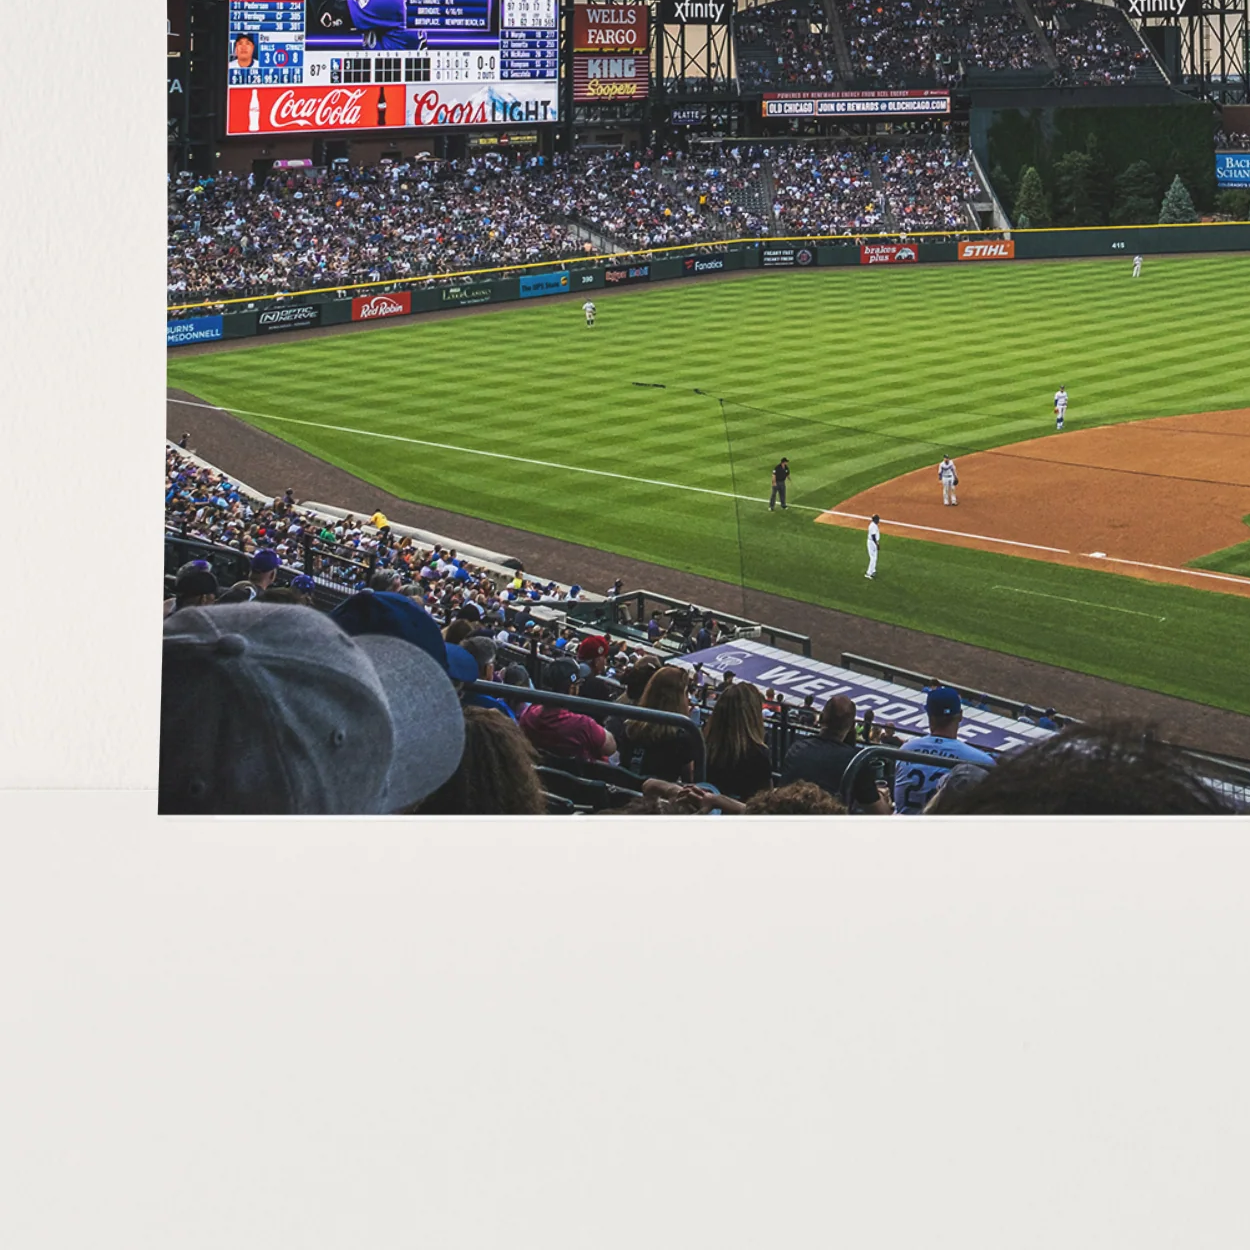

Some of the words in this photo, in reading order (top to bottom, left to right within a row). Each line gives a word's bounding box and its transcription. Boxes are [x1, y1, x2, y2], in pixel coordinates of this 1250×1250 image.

[586, 8, 637, 25] WELLS
[587, 29, 637, 45] FARGO
[477, 55, 495, 70] 0-0
[587, 58, 636, 79] KING
[586, 79, 638, 100] Soopers
[270, 88, 367, 128] Coca-Cola
[413, 90, 488, 126] Coors
[491, 100, 552, 122] LIGHT
[768, 102, 783, 114] OLD
[783, 102, 813, 114] CHICAGO
[818, 101, 835, 112] JOIN
[847, 100, 880, 112] REWARDS
[888, 99, 947, 111] OLDCHICAGO.COM
[673, 110, 699, 119] PLATTE
[864, 245, 897, 255] brakes
[963, 244, 1008, 257] STIHL
[868, 253, 890, 263] plus
[694, 260, 723, 271] Fanatics
[278, 312, 318, 322] NERVE
[279, 306, 313, 317] OPTIC
[360, 305, 379, 318] Red
[379, 303, 404, 315] Robin
